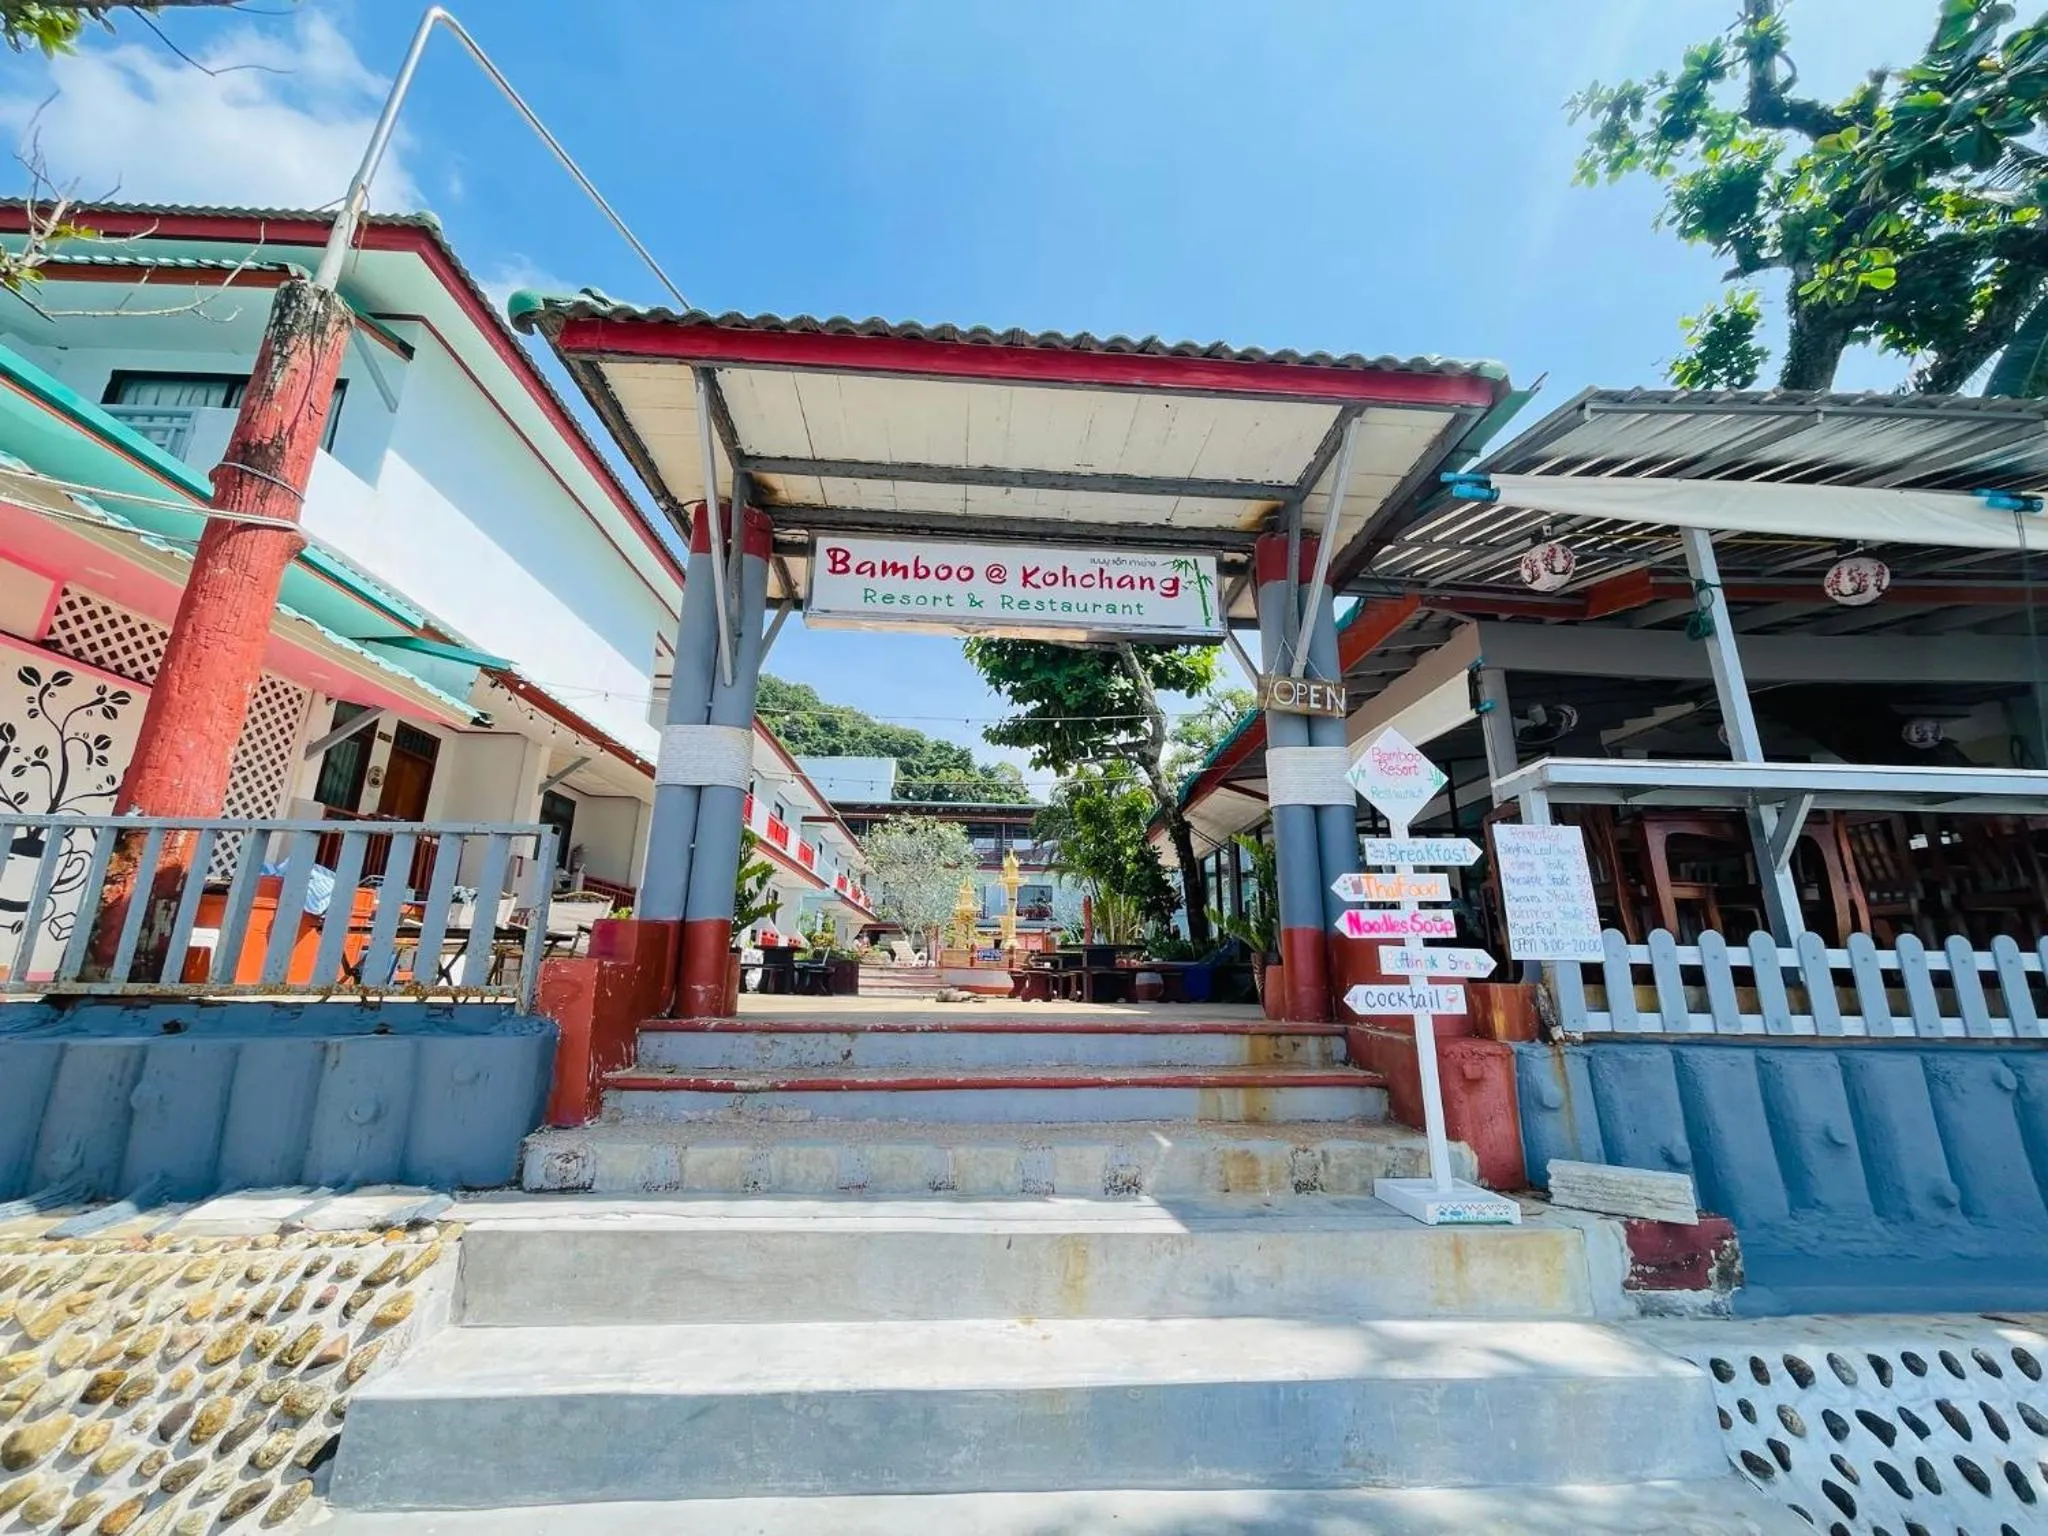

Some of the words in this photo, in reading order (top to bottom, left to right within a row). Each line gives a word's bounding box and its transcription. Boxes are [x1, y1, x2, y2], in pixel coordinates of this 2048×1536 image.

[826, 546, 975, 583] Bamboo
[985, 563, 1008, 585] @
[1021, 564, 1181, 598] Kohchang
[863, 587, 955, 608] Resort
[967, 592, 985, 609] &
[1001, 594, 1145, 616] Restaurant
[1273, 680, 1346, 712] OPEN
[1371, 746, 1423, 763] Bamboo
[1378, 761, 1419, 777] Resort
